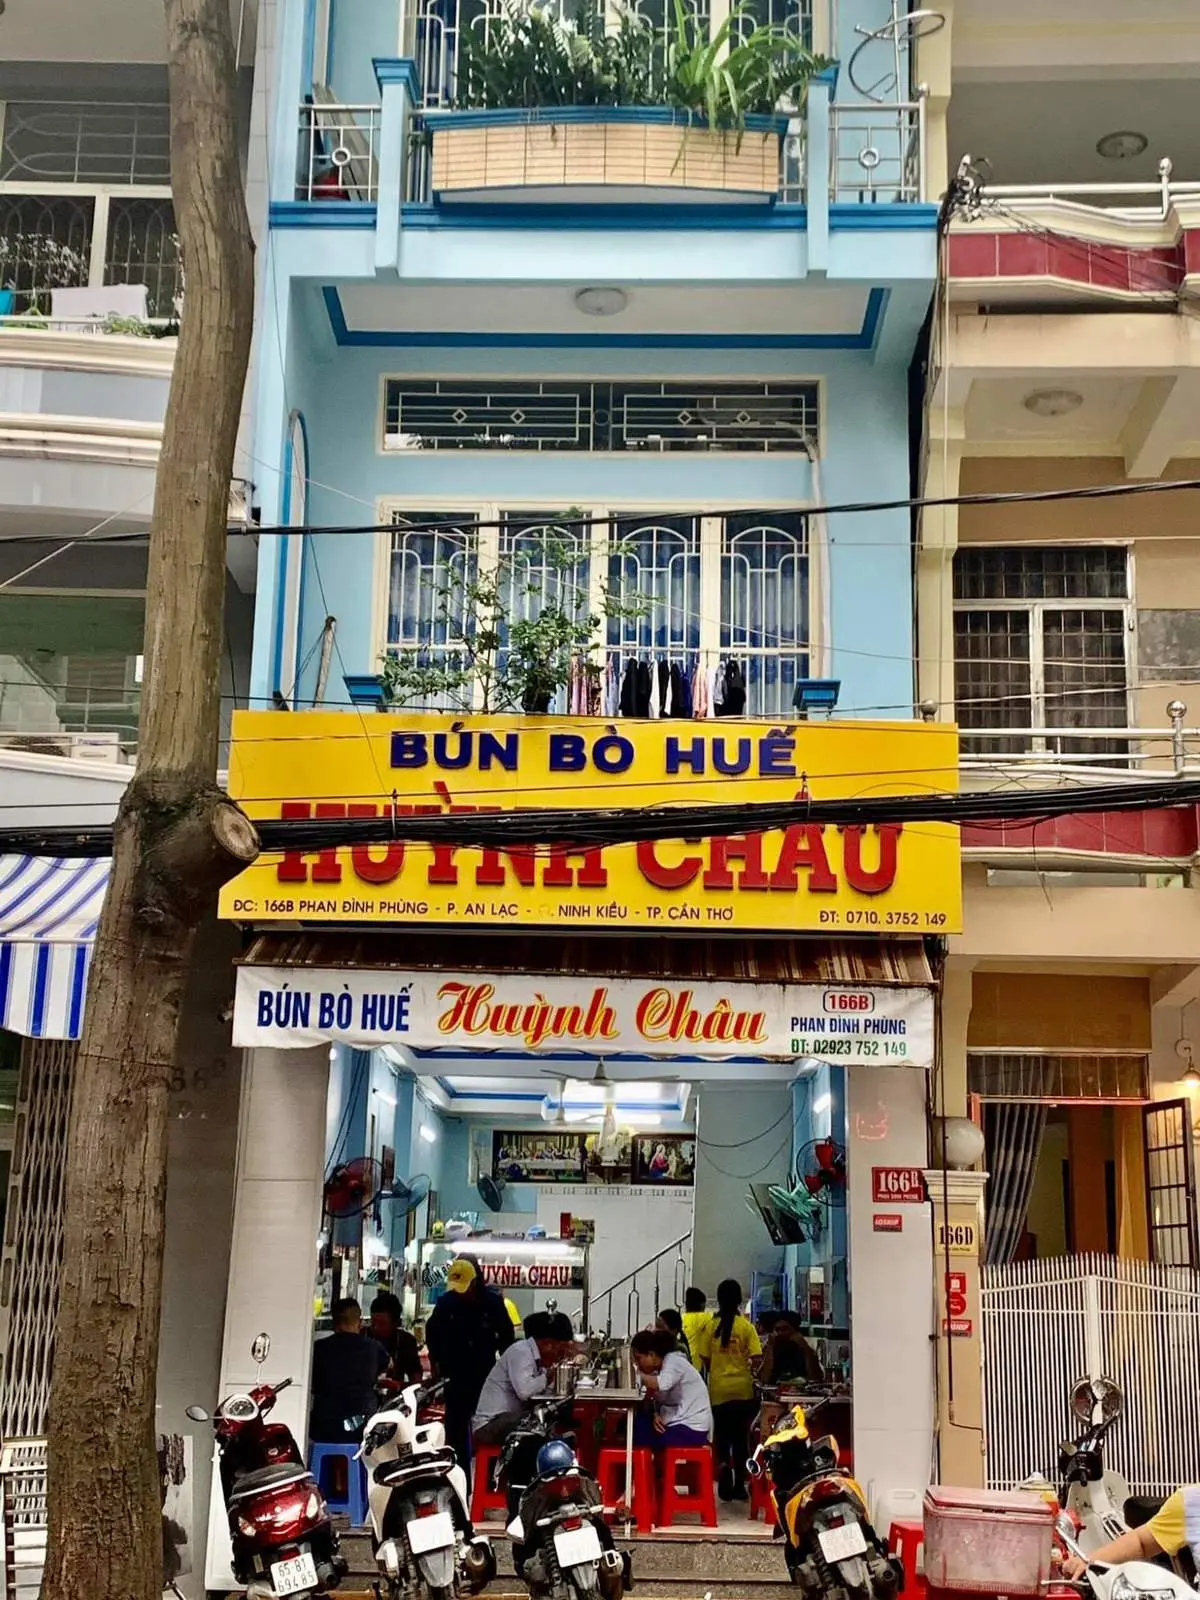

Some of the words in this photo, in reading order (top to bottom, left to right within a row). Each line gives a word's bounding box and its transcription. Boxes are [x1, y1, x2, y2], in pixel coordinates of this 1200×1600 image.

[390, 722, 519, 771] BÚN
[549, 724, 635, 774] BÒ
[665, 724, 797, 776] HUẾ
[233, 899, 259, 913] ĐC:
[264, 899, 294, 914] 166B
[299, 900, 337, 914] PHAN
[342, 897, 374, 914] ĐÌNH
[379, 898, 428, 915] PHÙNG
[447, 902, 459, 916] P.
[464, 903, 486, 916] AN
[491, 903, 519, 919] LẠC
[558, 904, 591, 918] NINH
[596, 900, 628, 919] KIỀU
[646, 906, 664, 920] TP.
[668, 902, 700, 920] CẦN
[706, 906, 734, 921] THƠ
[819, 910, 840, 925] ĐT:
[846, 911, 881, 925] 0710.
[886, 912, 919, 926] 3752
[925, 912, 947, 927] 149
[828, 994, 869, 1010] 166B
[256, 982, 312, 1029] BÚN
[318, 983, 353, 1030] BÒ
[360, 982, 414, 1032] HUẾ
[436, 981, 620, 1048] Huỳnh
[635, 986, 770, 1044] Châu
[791, 1016, 825, 1033] PHAN
[829, 1014, 860, 1034] ĐÌNH
[863, 1015, 906, 1035] PHÙNG
[791, 1038, 809, 1054] ĐT:
[813, 1039, 852, 1055] 02923
[856, 1040, 879, 1056] 752
[883, 1041, 907, 1057] 149
[938, 1225, 974, 1246] 166D
